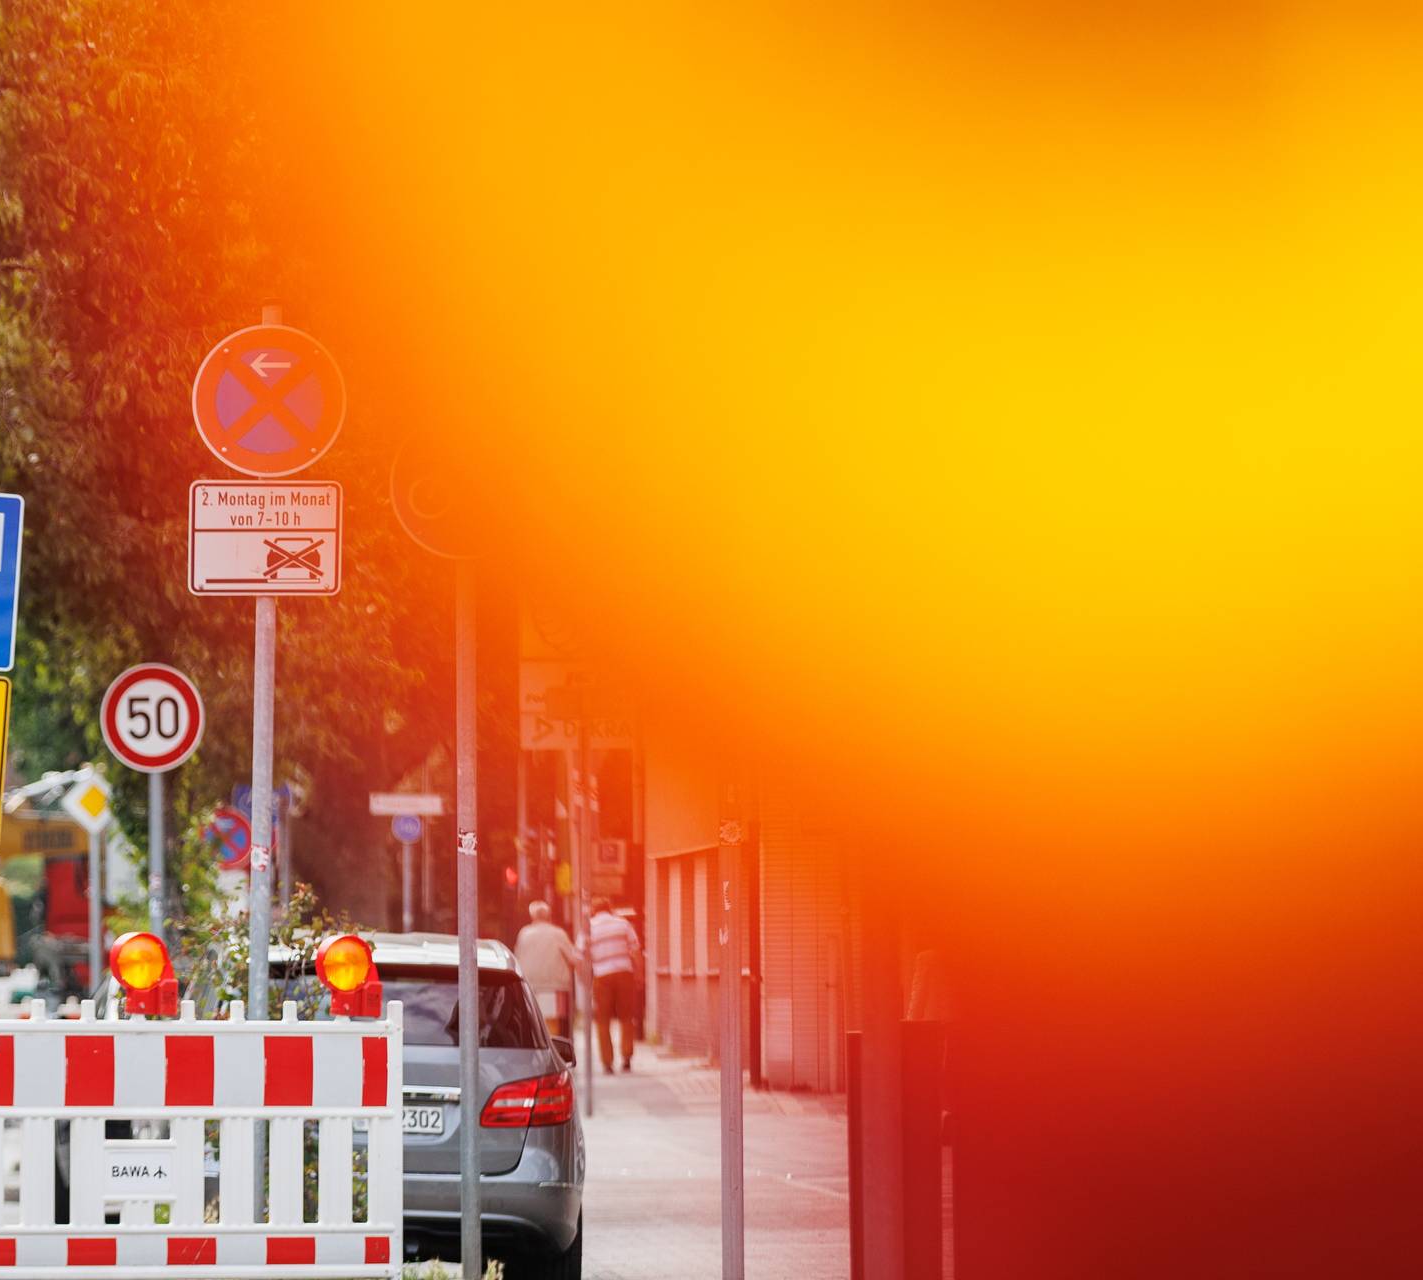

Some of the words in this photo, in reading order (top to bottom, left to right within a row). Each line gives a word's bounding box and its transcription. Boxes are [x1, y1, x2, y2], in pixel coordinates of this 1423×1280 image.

[202, 492, 213, 506] 2.
[218, 492, 265, 509] Montag
[270, 491, 286, 506] im
[290, 492, 331, 506] Monat
[230, 515, 252, 526] von
[294, 511, 301, 526] h
[128, 697, 179, 739] 50
[563, 719, 633, 738] DKRA
[111, 1165, 150, 1178] BAWA
